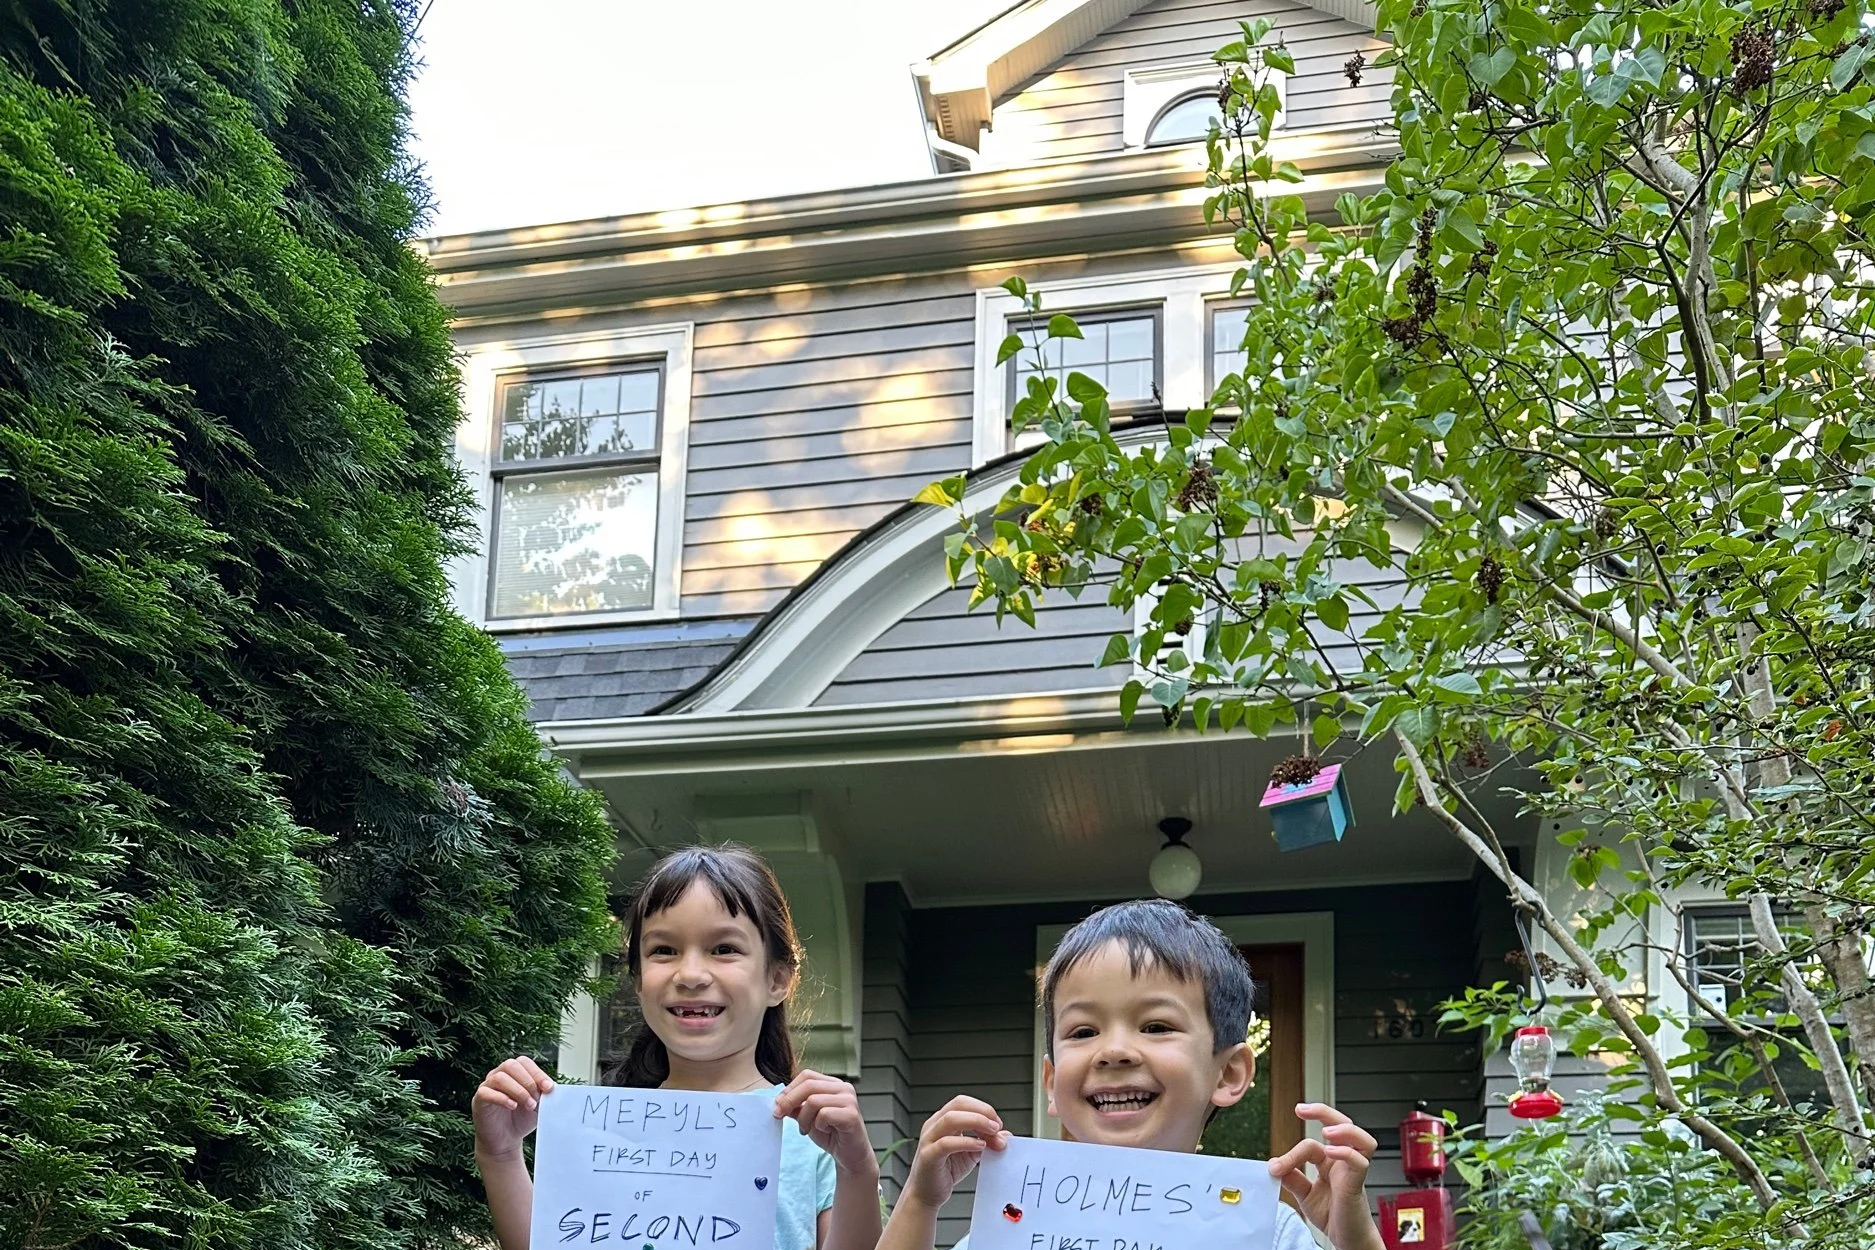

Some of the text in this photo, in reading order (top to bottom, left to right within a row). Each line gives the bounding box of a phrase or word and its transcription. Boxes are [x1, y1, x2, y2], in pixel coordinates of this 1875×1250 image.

[582, 1094, 737, 1132] MERYL'S
[592, 1145, 717, 1170] FIRST DAY
[634, 1189, 654, 1202] OF
[1020, 1164, 1213, 1216] HOLMES'
[558, 1207, 741, 1246] SECOND
